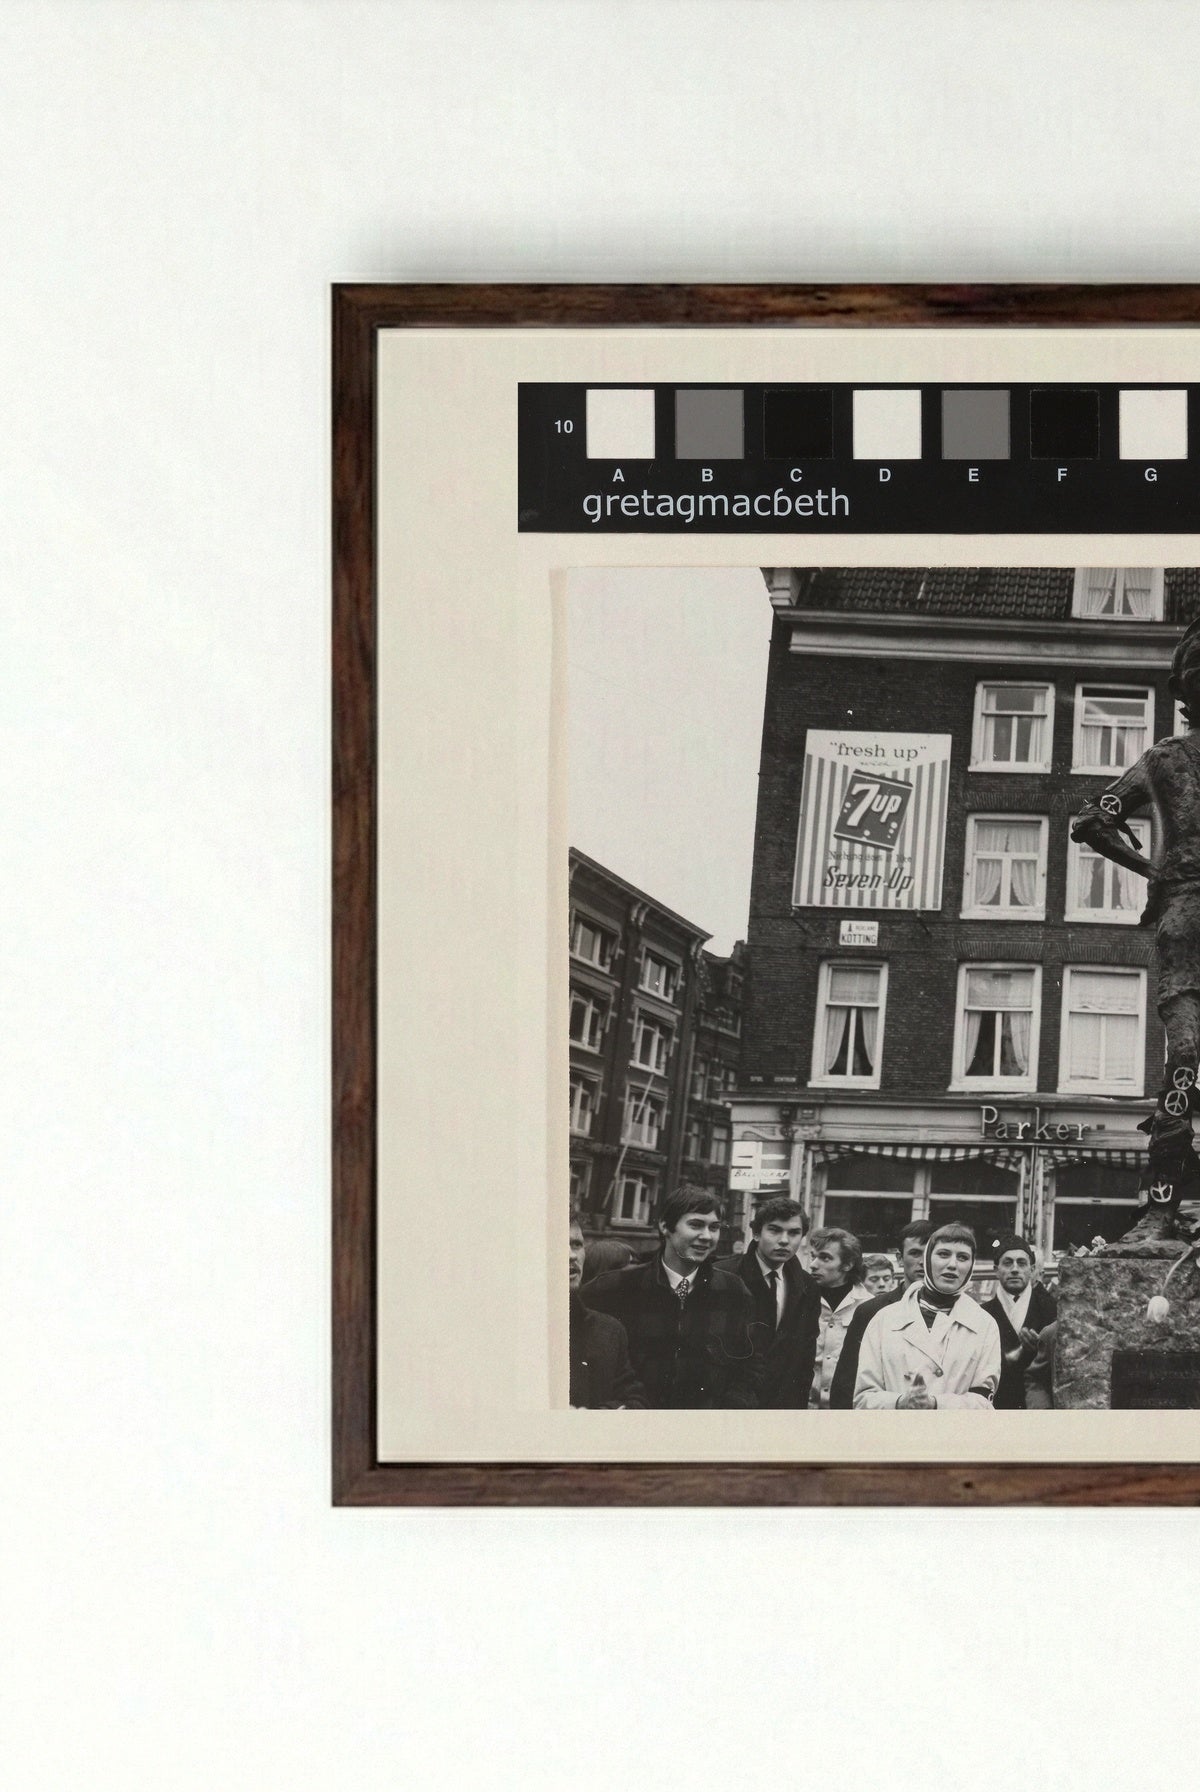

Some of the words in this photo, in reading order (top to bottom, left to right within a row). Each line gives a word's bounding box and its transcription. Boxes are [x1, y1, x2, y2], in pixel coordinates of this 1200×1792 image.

[554, 419, 574, 434] 10
[612, 468, 625, 482] A
[701, 468, 714, 482] B
[790, 468, 803, 483] C
[879, 468, 892, 482] D
[968, 468, 980, 482] E
[1057, 467, 1068, 482] F
[1144, 467, 1158, 482] G
[582, 487, 849, 523] gretagmacbeth
[823, 865, 914, 898] Seven-Up
[980, 1105, 1091, 1141] Parker
